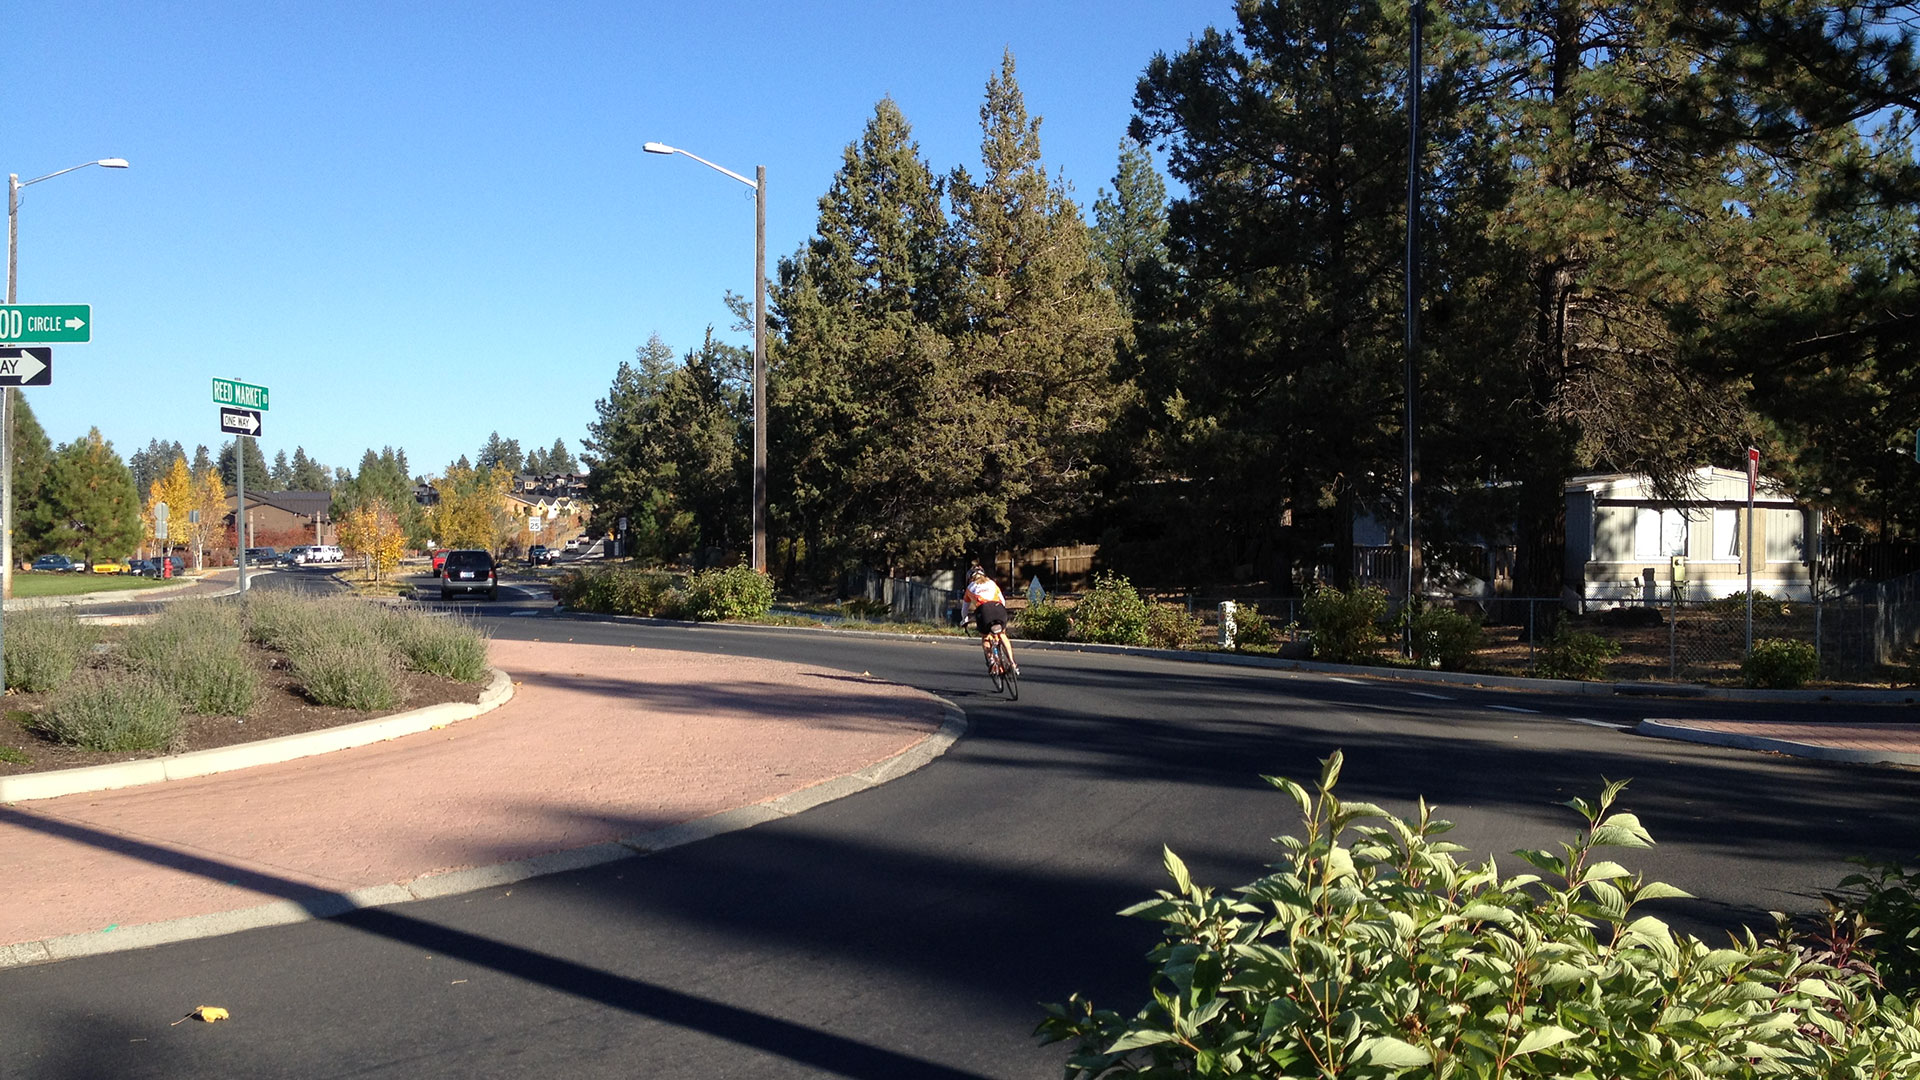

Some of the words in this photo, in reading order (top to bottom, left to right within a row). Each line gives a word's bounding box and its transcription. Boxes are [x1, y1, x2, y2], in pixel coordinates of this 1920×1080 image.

[0, 309, 22, 339] OD
[27, 316, 62, 332] CIRCLE
[0, 360, 19, 374] AY
[214, 380, 233, 402] REED
[235, 384, 262, 408] MARKET
[224, 415, 236, 426] ONE
[238, 417, 250, 427] WAY
